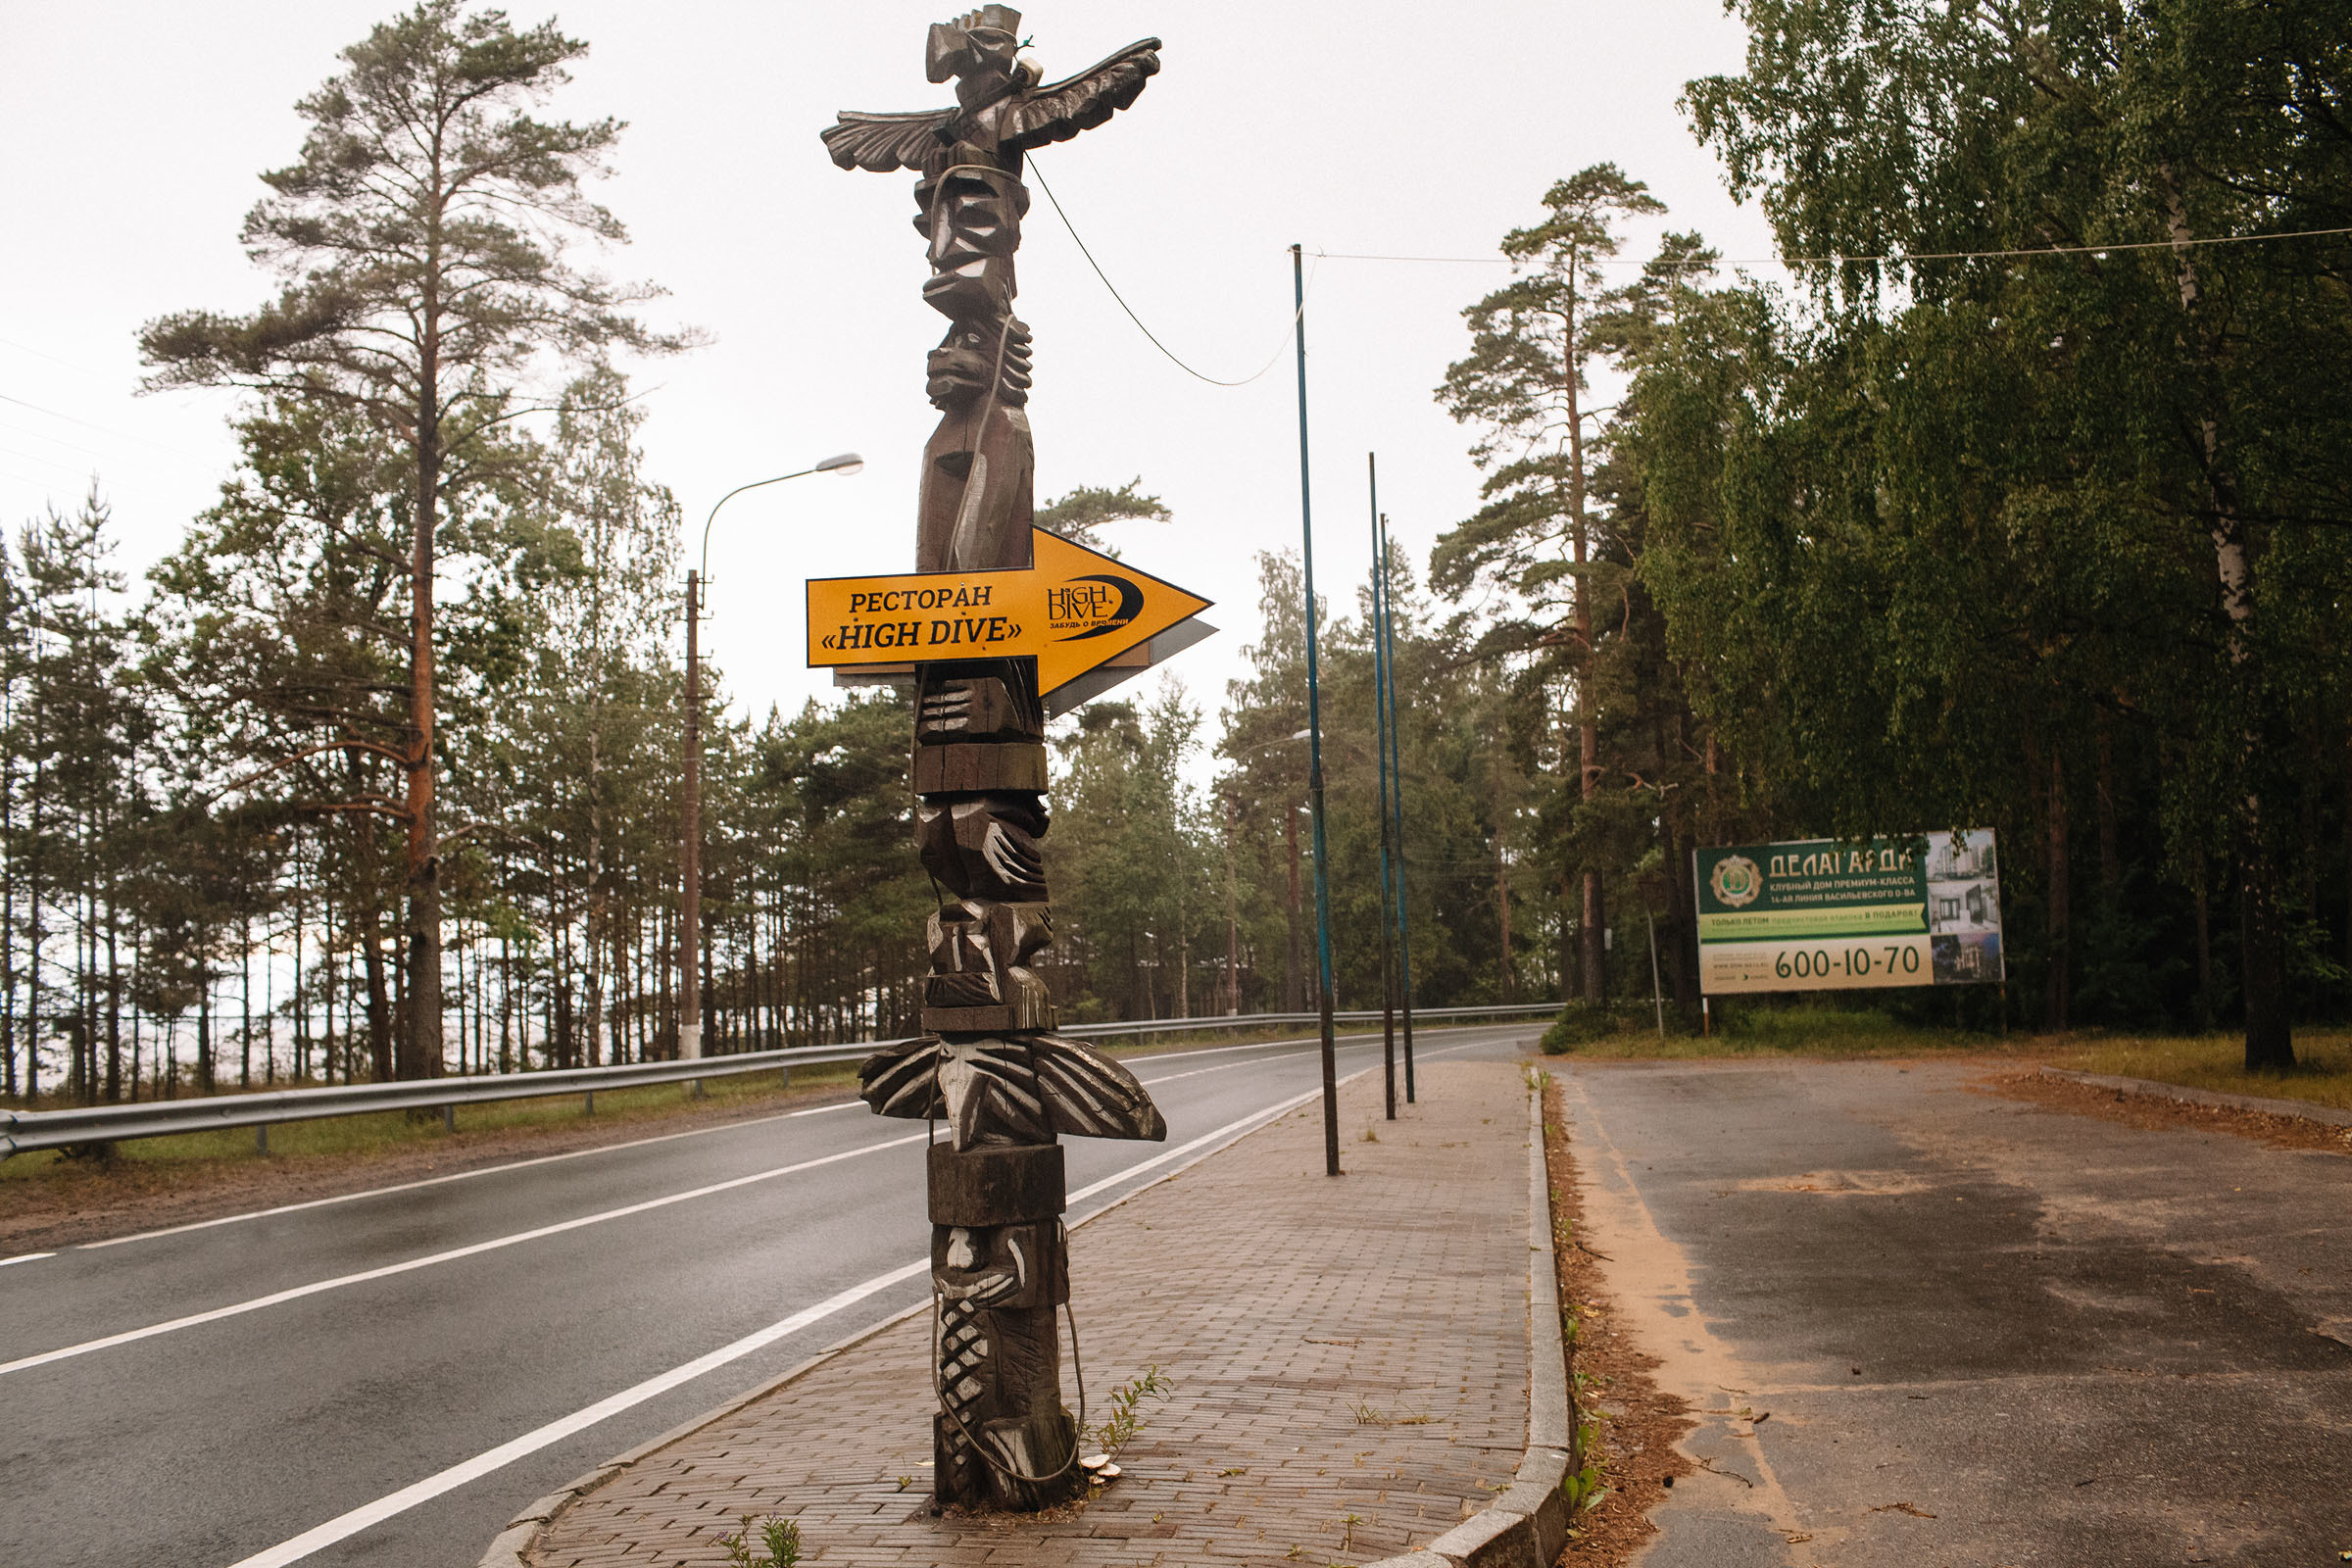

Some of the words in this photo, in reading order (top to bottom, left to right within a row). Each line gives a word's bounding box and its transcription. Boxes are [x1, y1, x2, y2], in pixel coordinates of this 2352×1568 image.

[849, 585, 993, 613] РЕСТОРАН
[1048, 602, 1108, 620] DIVE
[821, 621, 922, 651] «HIGH
[928, 616, 1022, 646] DIVE»
[1770, 880, 1811, 892] КЛУБНЫЙ
[1813, 879, 1833, 891] ДОМ
[1834, 876, 1915, 889] ПРЕМИУМ-КЛАССА
[1795, 893, 1823, 903] ЛИНИЯ
[1825, 890, 1893, 902] ВАСИЛЬЕВСКОГО
[1775, 945, 1920, 979] 600-10-70
